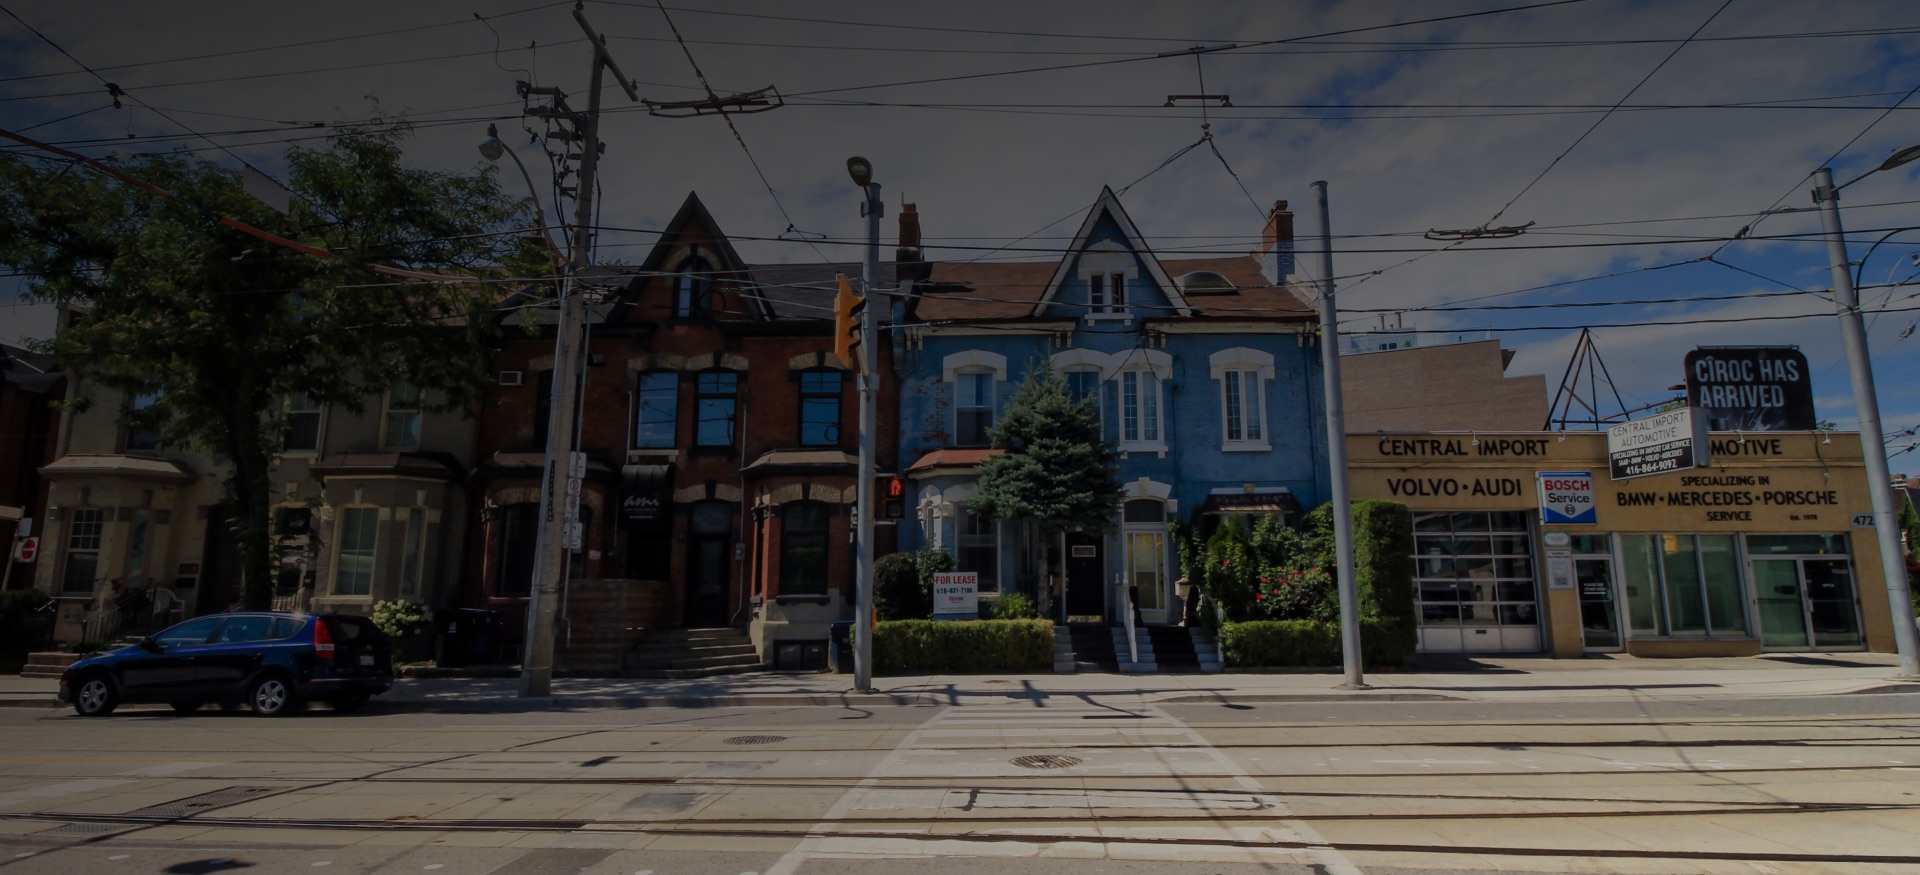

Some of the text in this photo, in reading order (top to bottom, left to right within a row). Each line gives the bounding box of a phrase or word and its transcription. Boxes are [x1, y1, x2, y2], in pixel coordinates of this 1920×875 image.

[1695, 355, 1799, 382] CÎROC HAS
[1700, 384, 1785, 408] ARRIVED
[1612, 412, 1685, 437] CENTRAL IMPORT
[1621, 427, 1676, 447] AUTOMOTIVE
[1379, 439, 1783, 456] CENTRAL IMPORT MOTIVE
[1612, 449, 1639, 460] SPECIALIZING
[1645, 445, 1662, 455] IMPORT
[1662, 442, 1671, 451] CAR
[1671, 439, 1690, 450] SERVICE
[1645, 454, 1660, 462] VOLVO
[1662, 449, 1683, 459] MERCEDES
[1625, 459, 1678, 475] 416-864-9092
[1387, 478, 1522, 496] VOLVO AUDI
[1544, 479, 1590, 491] BOSCH
[1680, 475, 1770, 487] SPECIALIZING IN
[1548, 492, 1590, 503] Service
[1617, 490, 1838, 506] BMW MERCEDES PORSCHE
[1706, 510, 1753, 522] SERVICE
[1853, 515, 1875, 526] 472
[935, 575, 976, 585] FOR LEASE
